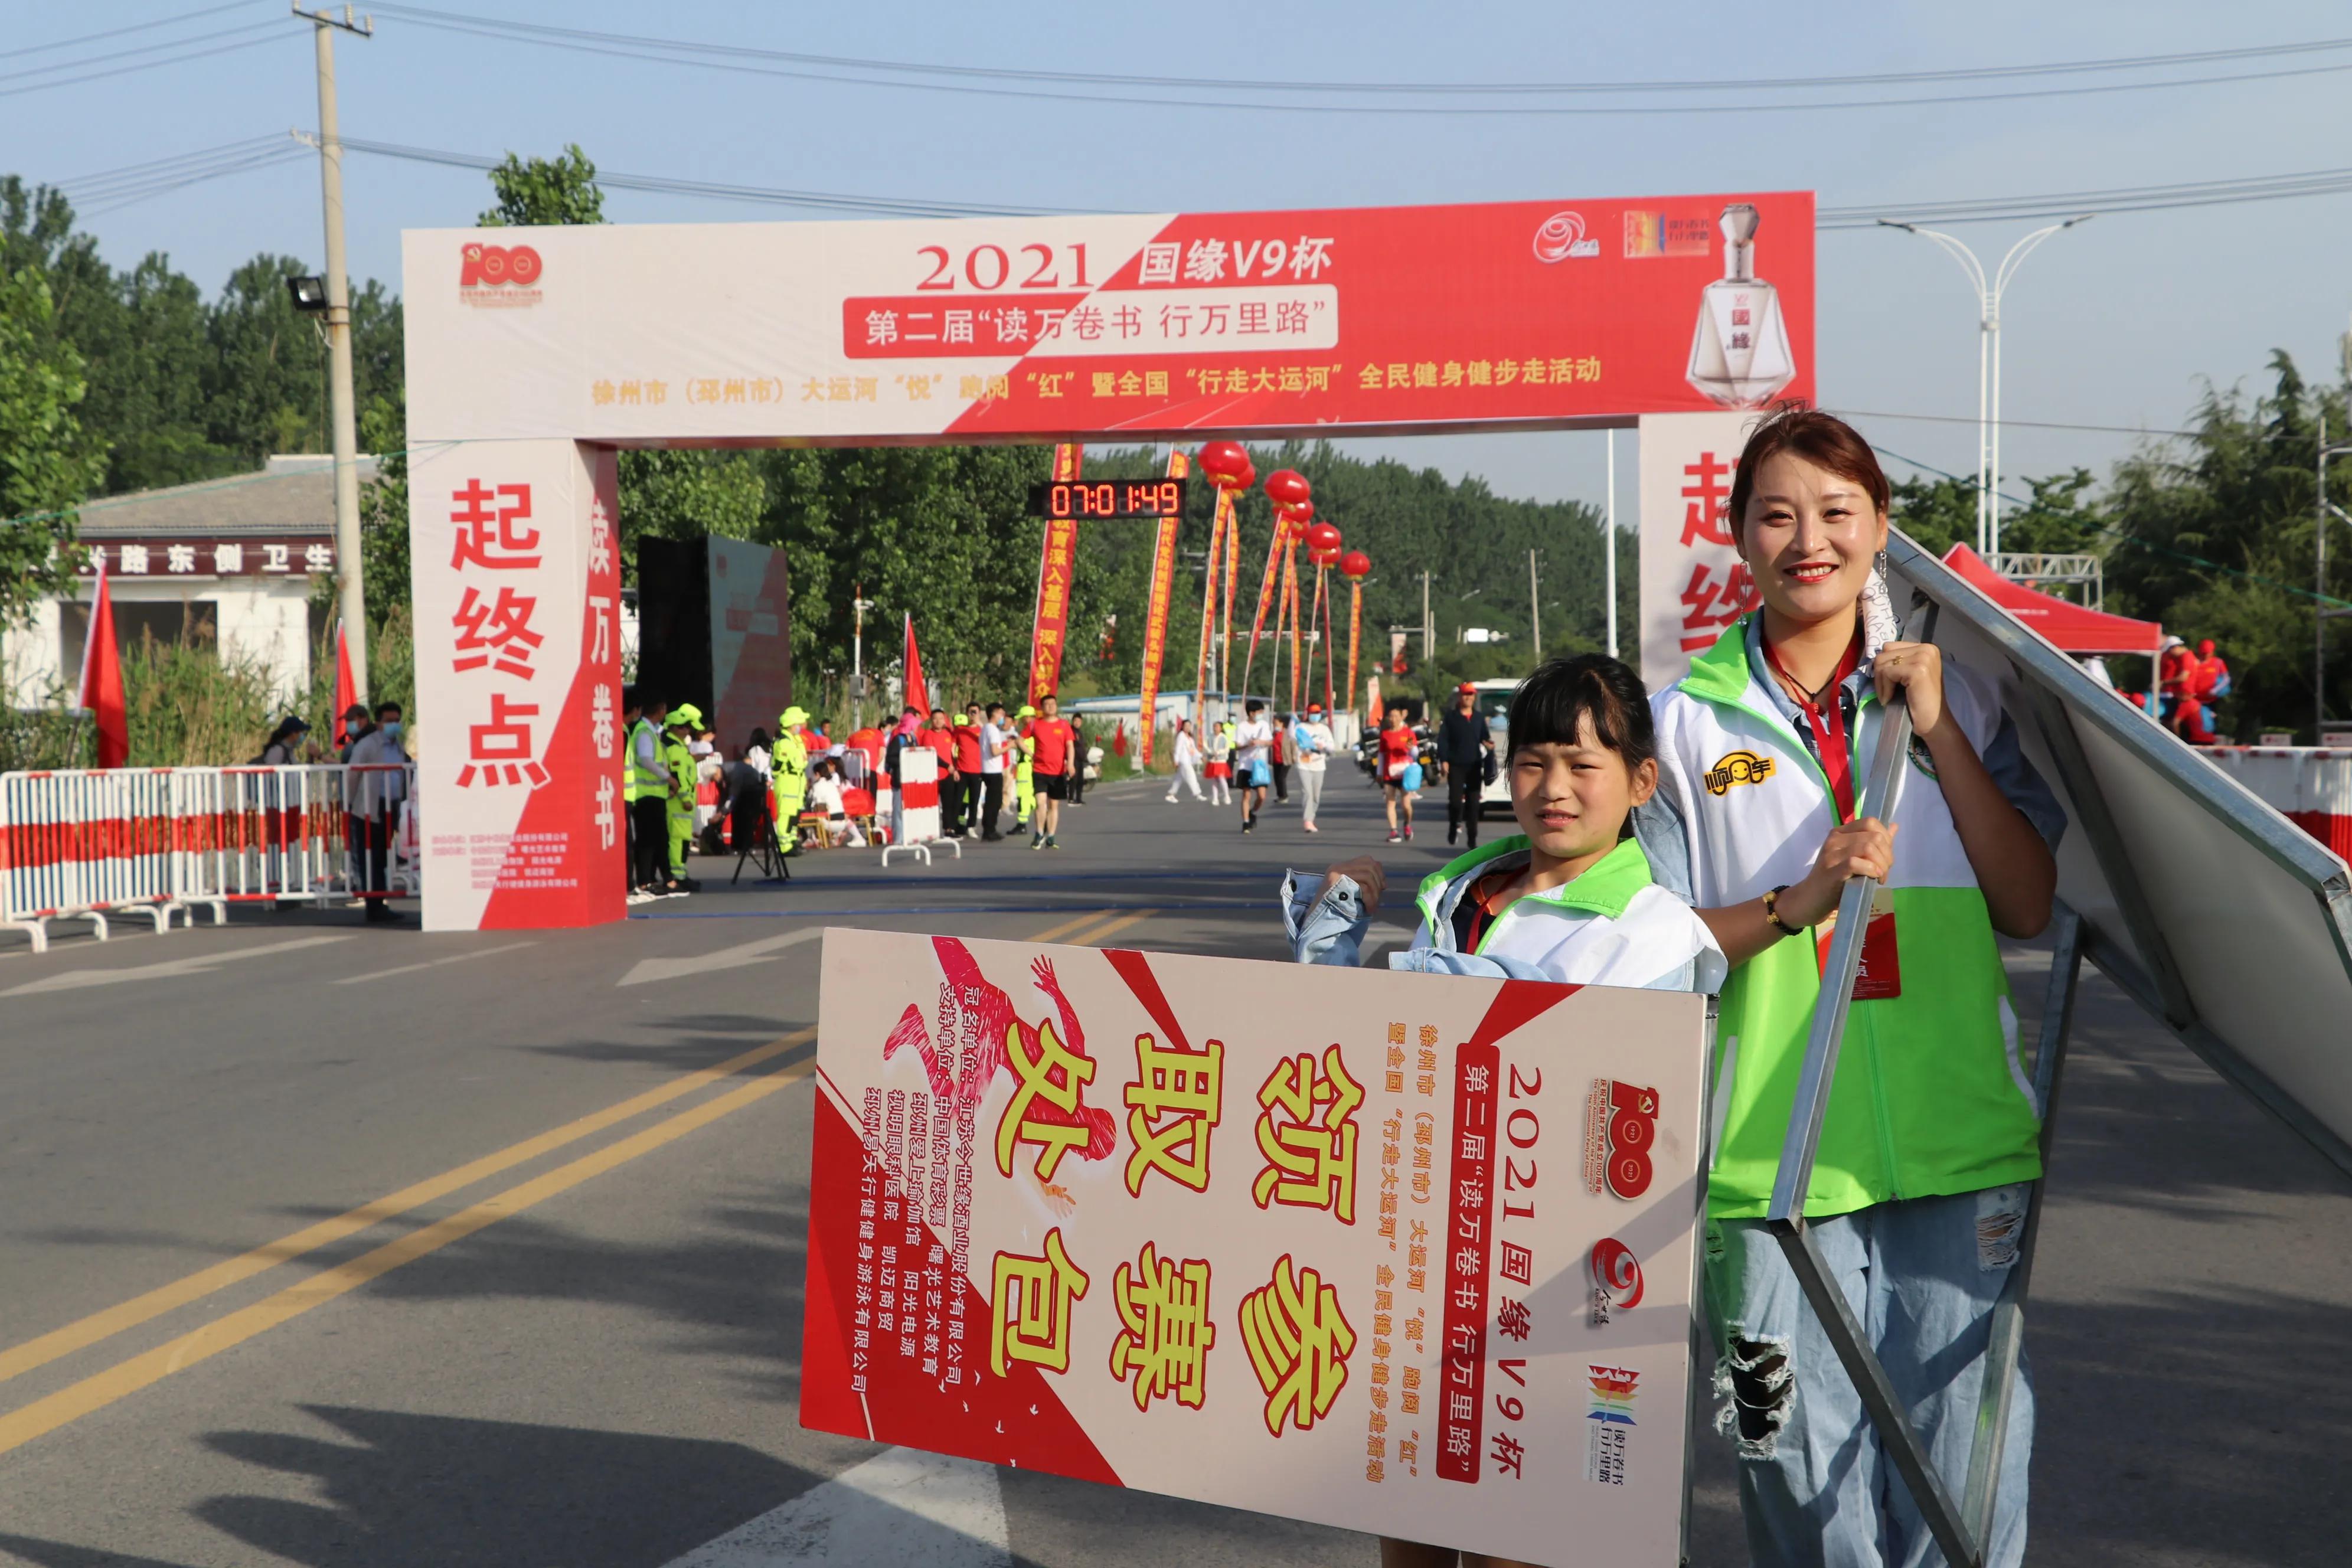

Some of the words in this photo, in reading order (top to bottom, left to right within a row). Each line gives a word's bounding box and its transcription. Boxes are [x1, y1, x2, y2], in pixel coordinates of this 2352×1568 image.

[865, 303, 1141, 345] 第二届“读万卷书
[1159, 299, 1326, 338] 行万里路”
[916, 243, 1096, 290] 2021
[1138, 236, 1334, 285] 国缘V9杯
[1051, 483, 1178, 517] 07:01:49
[450, 478, 551, 790] 起终点
[589, 499, 616, 851] 读万卷书
[881, 1090, 904, 1221] 视明眼科医院
[904, 1092, 927, 1246] 邳州爱上瑜伽馆
[930, 1096, 951, 1228] 中国体育彩票
[1454, 1064, 1490, 1309] 第二届“读万卷书
[1595, 1079, 1607, 1194] 庆祝中国共产党成立100周年
[851, 1087, 881, 1394] 邳州易天行健健身游泳有限公司
[877, 1245, 896, 1332] 凯迈商贸
[944, 1096, 975, 1386] 江苏今世缘酒业股份有限公司
[899, 1270, 919, 1359] 阳光电源
[922, 1244, 943, 1377] 曙光艺术教育
[1446, 1324, 1476, 1472] 行万里路”
[1599, 1427, 1613, 1483] 行万里路
[1612, 1429, 1626, 1485] 读万卷书
